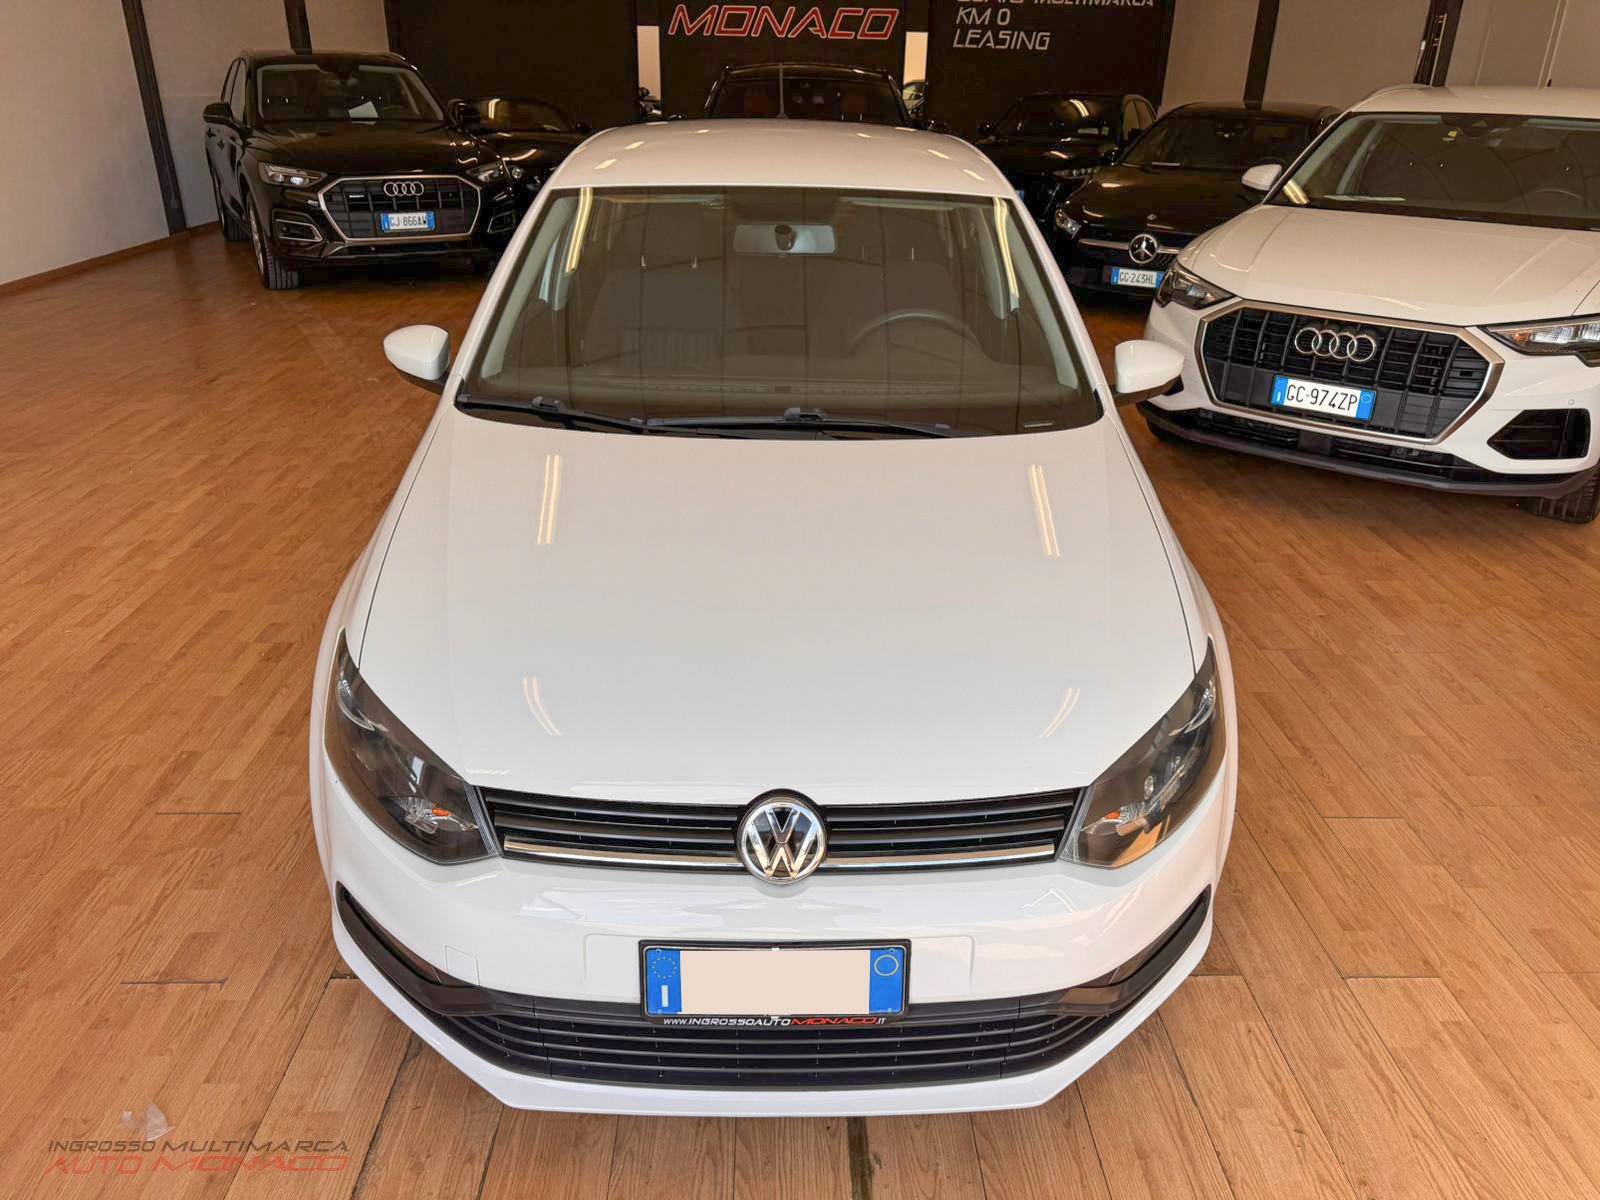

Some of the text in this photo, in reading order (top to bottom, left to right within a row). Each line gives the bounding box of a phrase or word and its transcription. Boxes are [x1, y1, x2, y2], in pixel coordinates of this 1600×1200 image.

[668, 4, 899, 40] MONACO
[956, 7, 991, 25] KM
[953, 29, 1051, 50] LEASING
